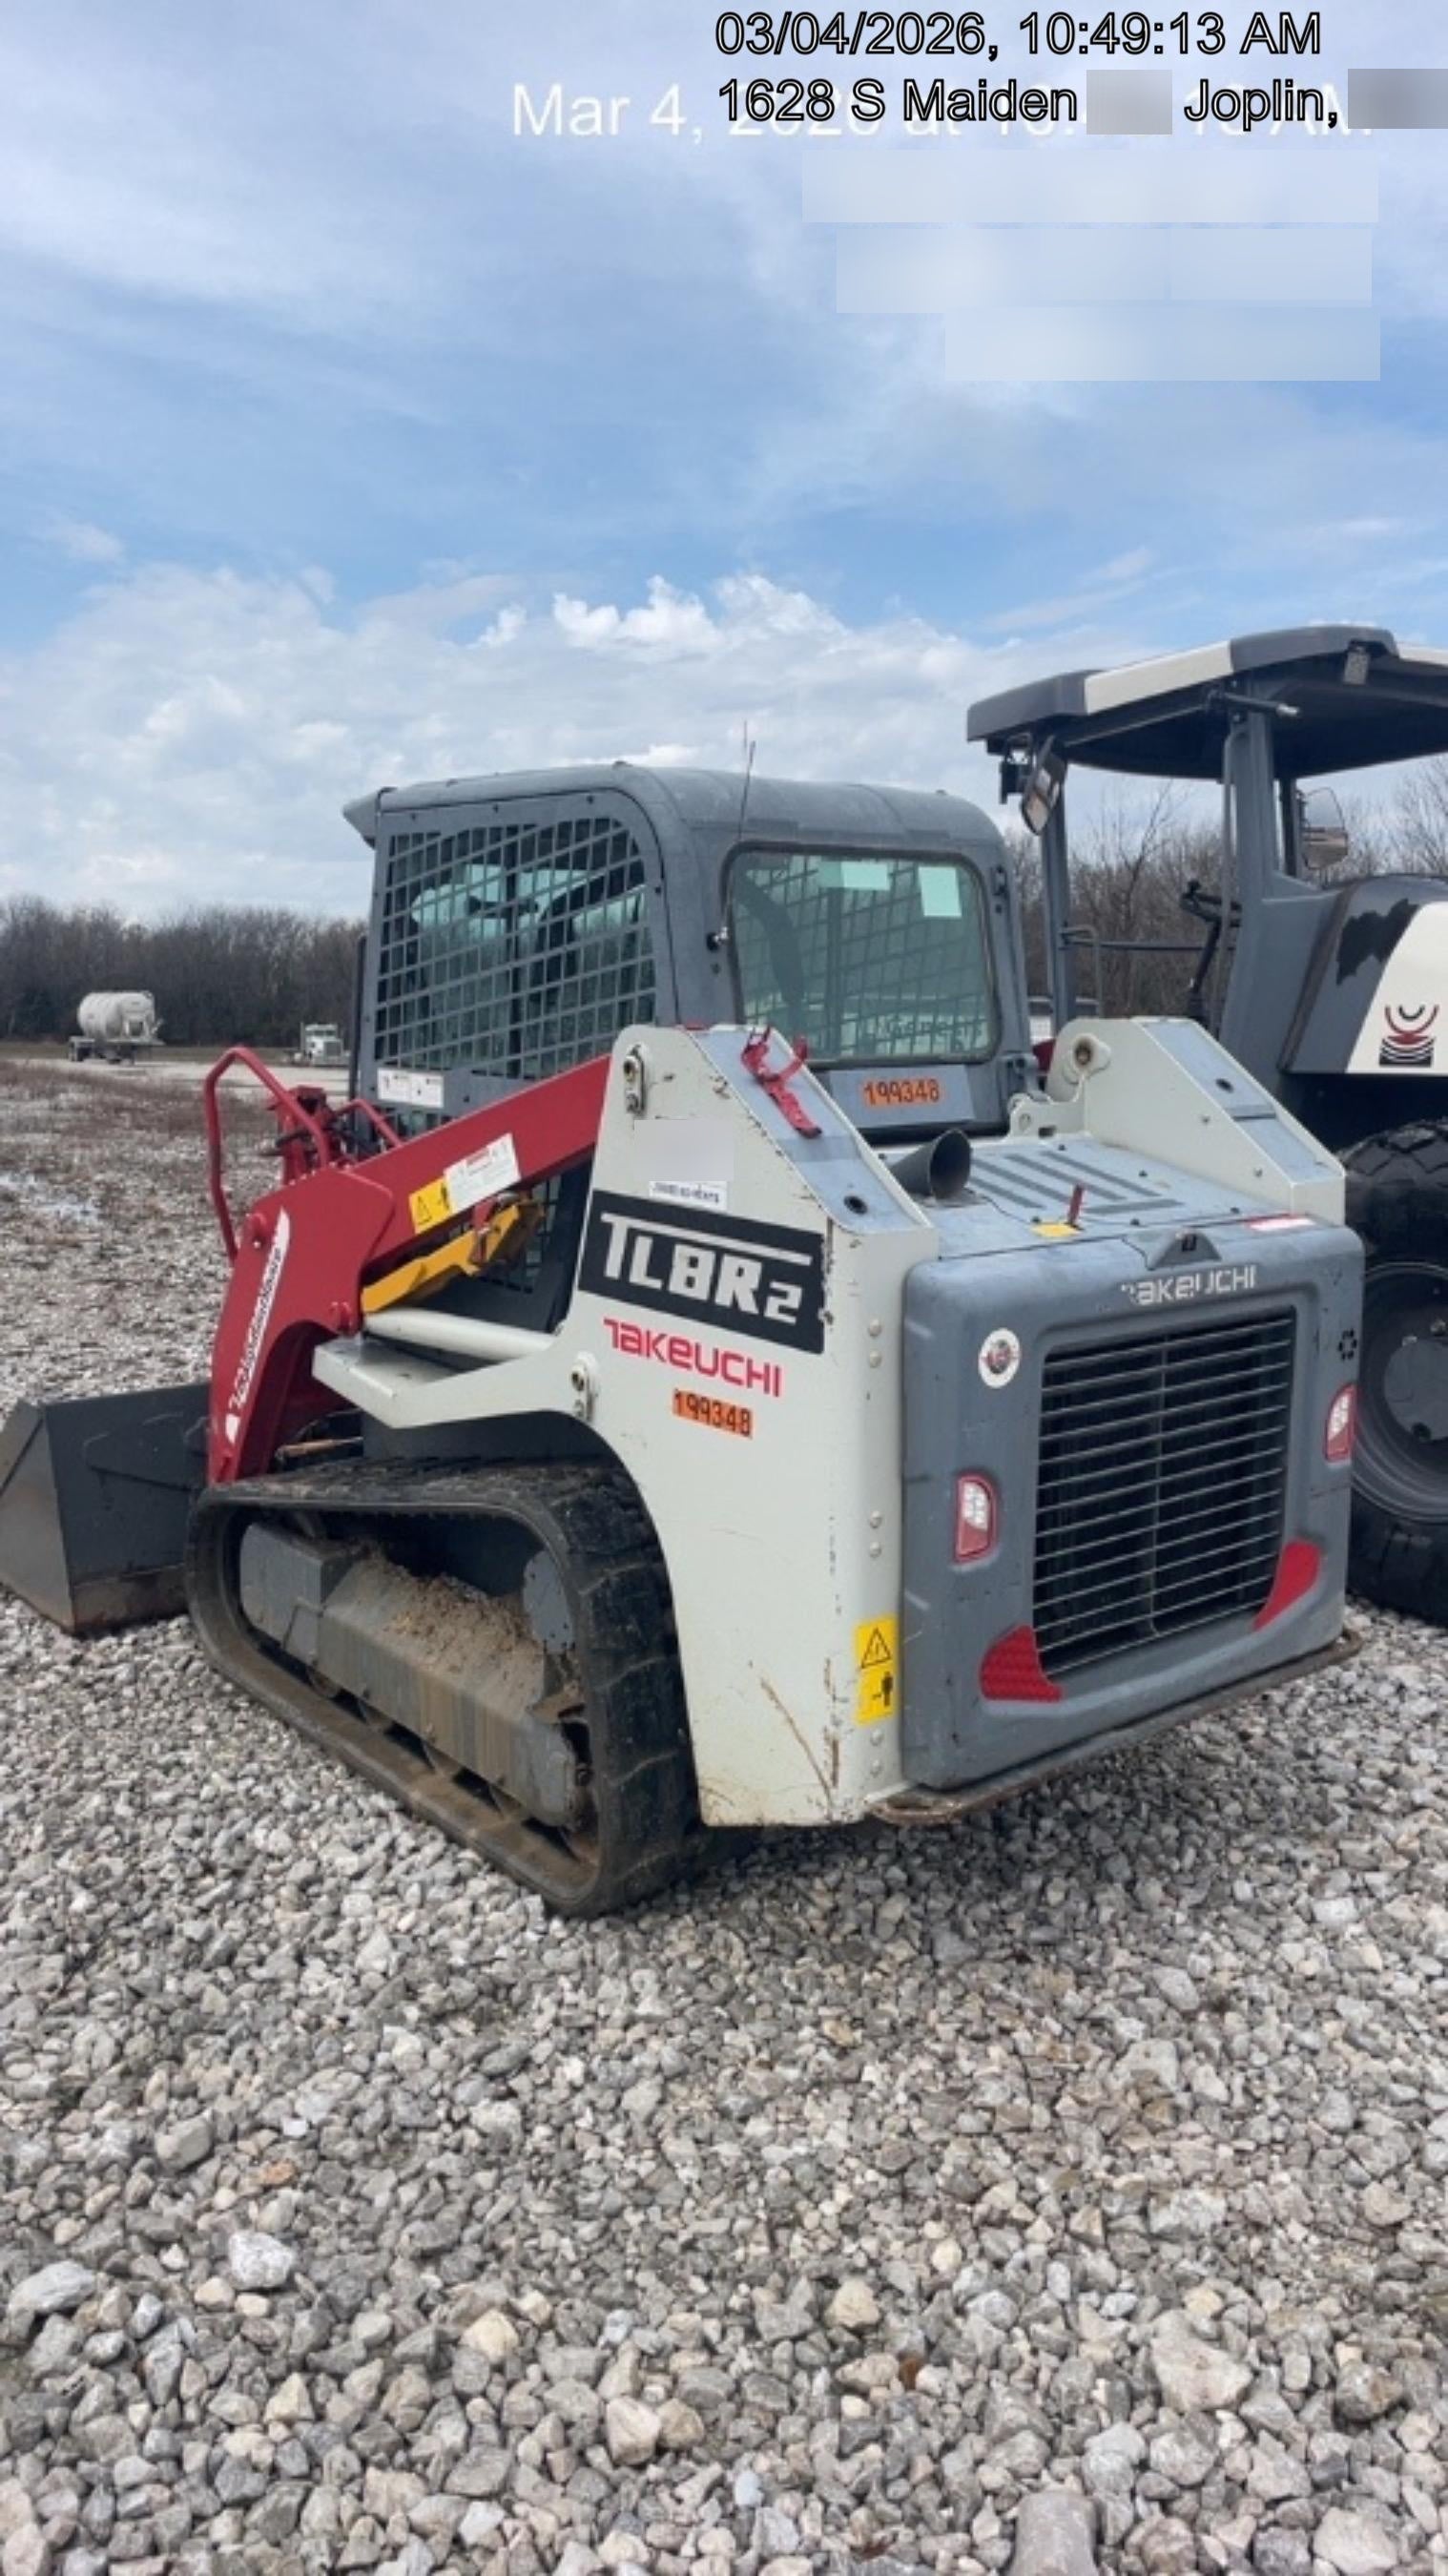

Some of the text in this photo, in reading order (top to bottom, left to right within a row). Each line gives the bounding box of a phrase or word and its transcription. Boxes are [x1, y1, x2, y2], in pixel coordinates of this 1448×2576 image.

[863, 1077, 941, 1106] 199348
[602, 1317, 783, 1398] TAKEUCHI
[673, 1389, 752, 1437] 199348
